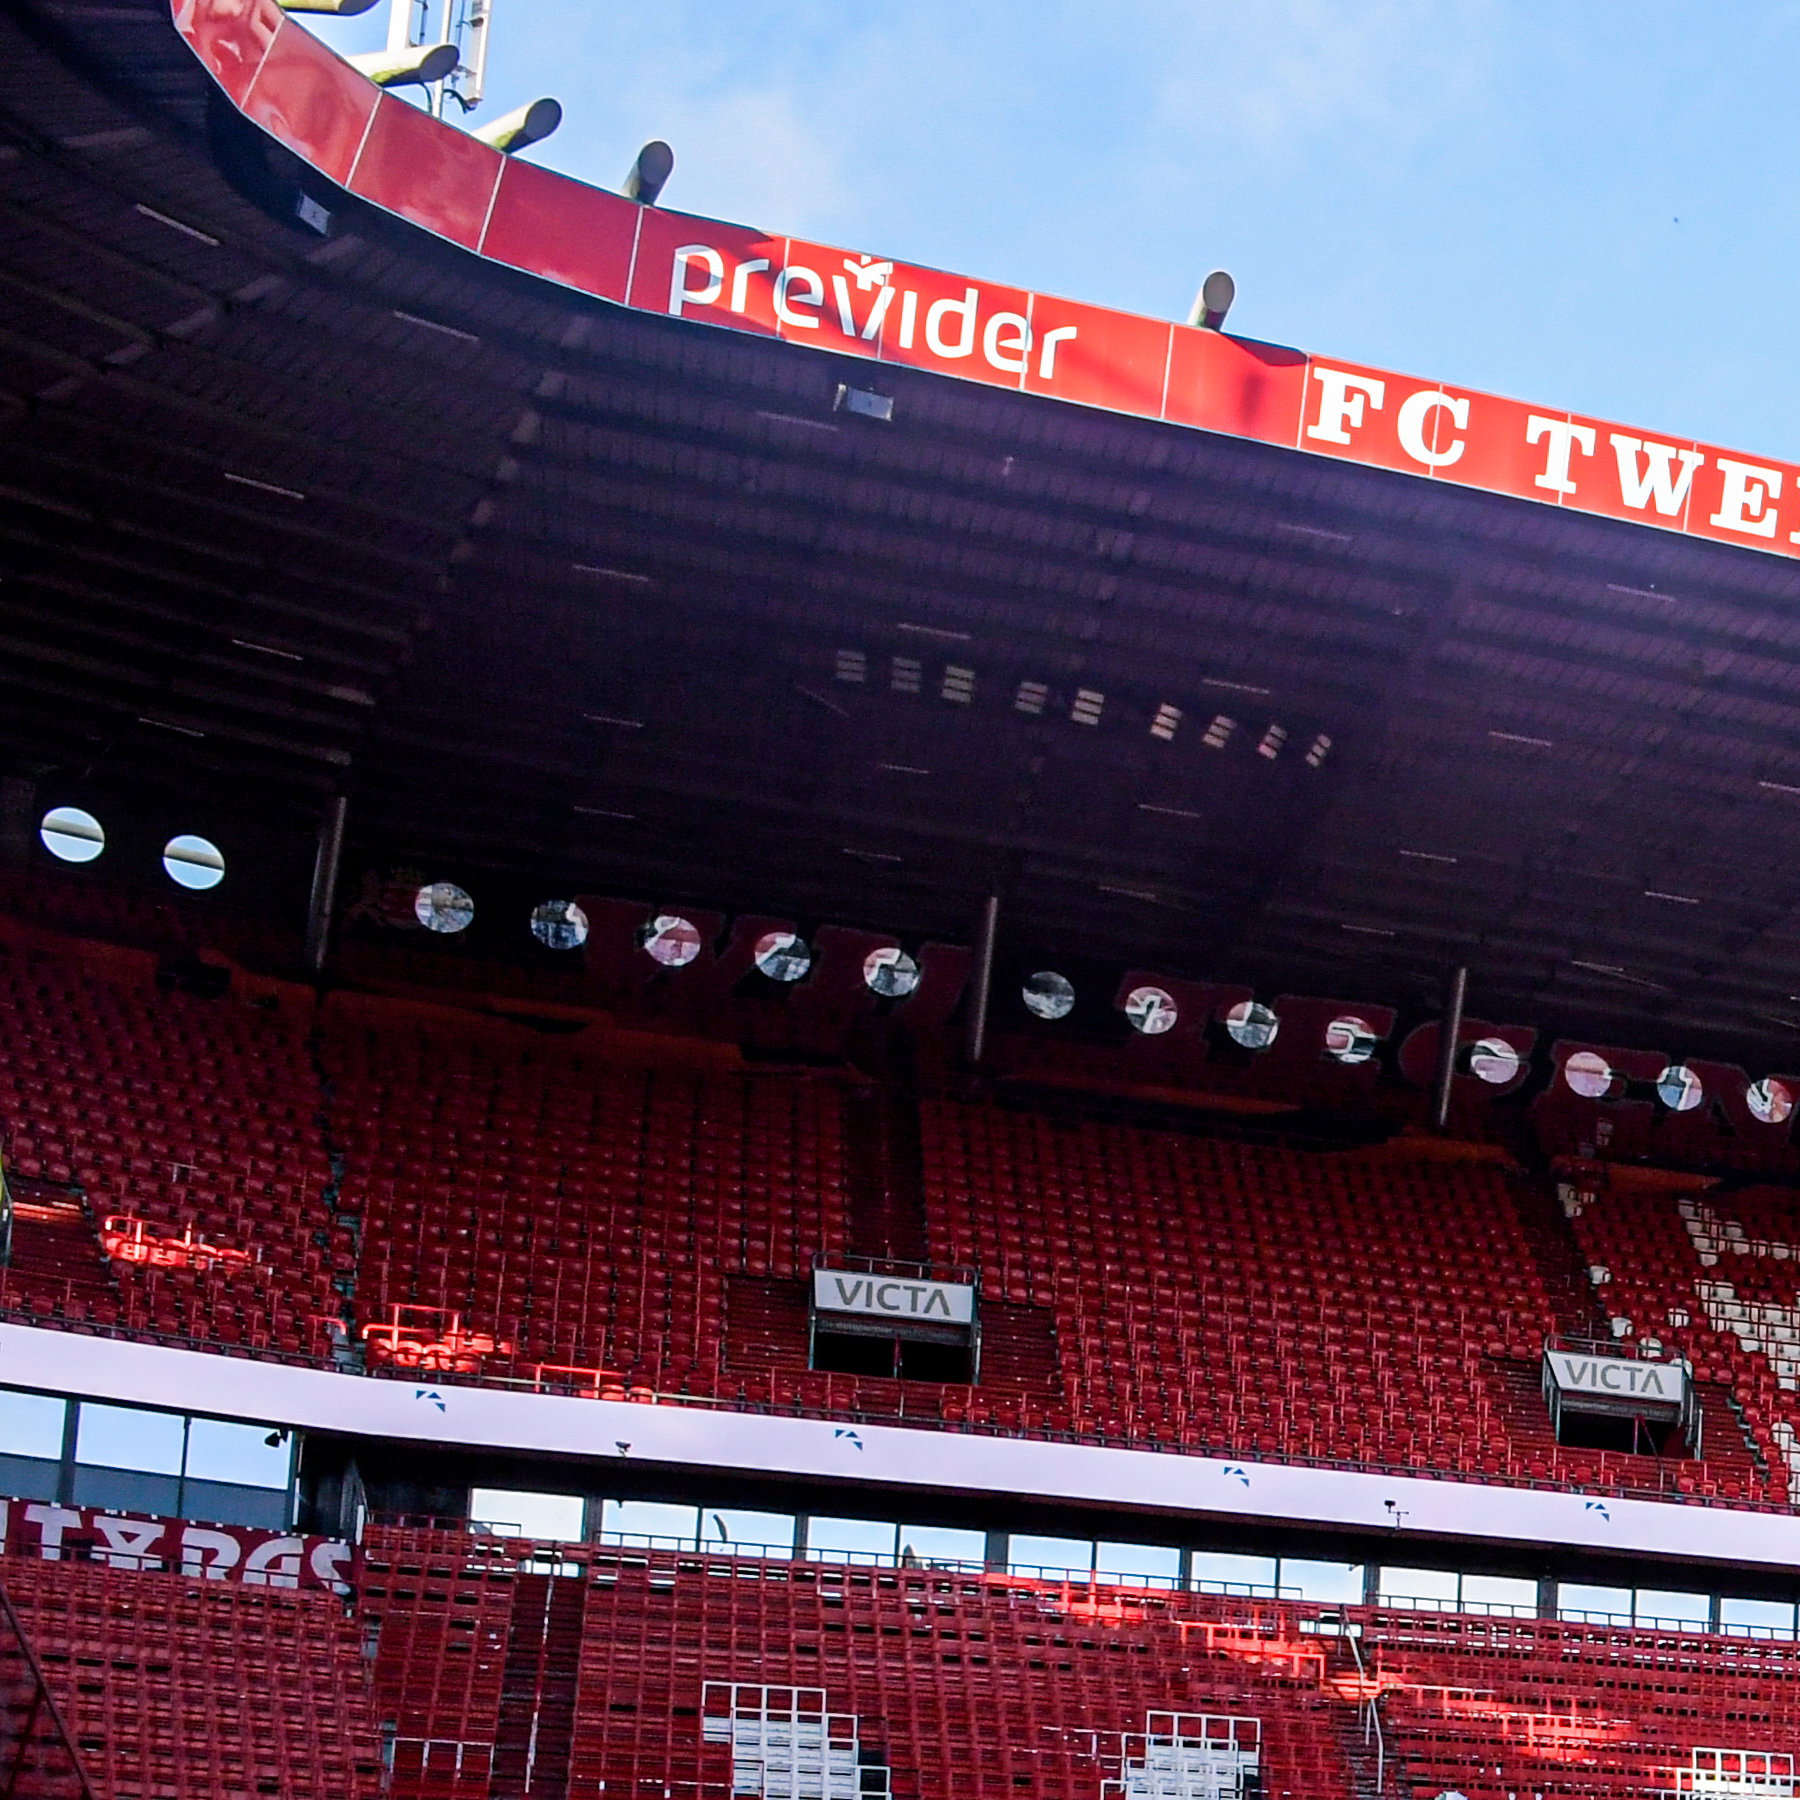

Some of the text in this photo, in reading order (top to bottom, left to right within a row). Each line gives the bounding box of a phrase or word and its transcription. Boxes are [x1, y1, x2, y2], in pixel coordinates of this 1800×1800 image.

[670, 244, 1077, 381] previder
[1307, 367, 1469, 466] FC
[835, 1278, 951, 1316] VICTA
[1565, 1360, 1664, 1394] VICTA
